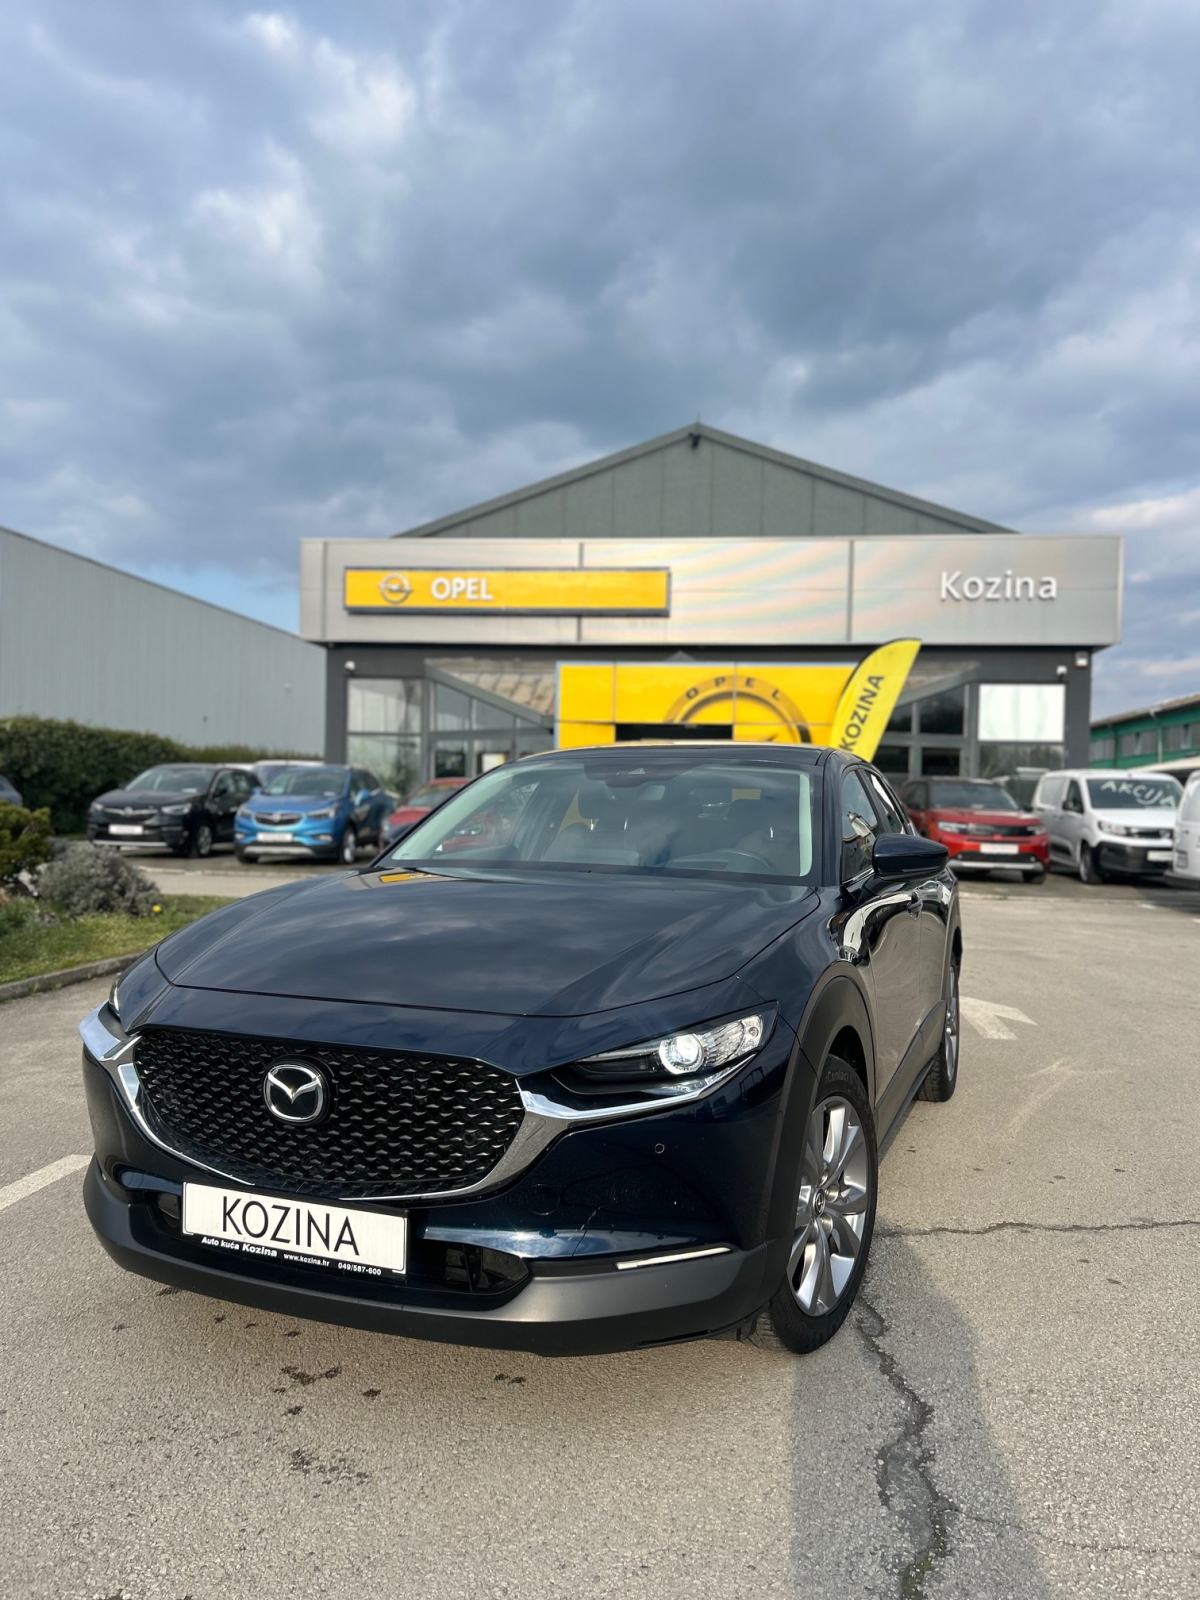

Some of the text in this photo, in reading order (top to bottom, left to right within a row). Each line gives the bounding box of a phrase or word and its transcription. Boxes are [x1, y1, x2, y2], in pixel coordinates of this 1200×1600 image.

[431, 577, 493, 601] OPEL
[940, 569, 1058, 601] Kozina
[685, 676, 782, 700] OPEL
[840, 674, 885, 752] KOZINA
[1101, 779, 1176, 807] AKCIJA
[223, 1196, 360, 1255] KOZINA
[201, 1236, 220, 1246] Auto
[242, 1243, 278, 1257] Kozina
[283, 1253, 330, 1267] www.kozina.hr
[337, 1262, 382, 1275] 049/587-600
